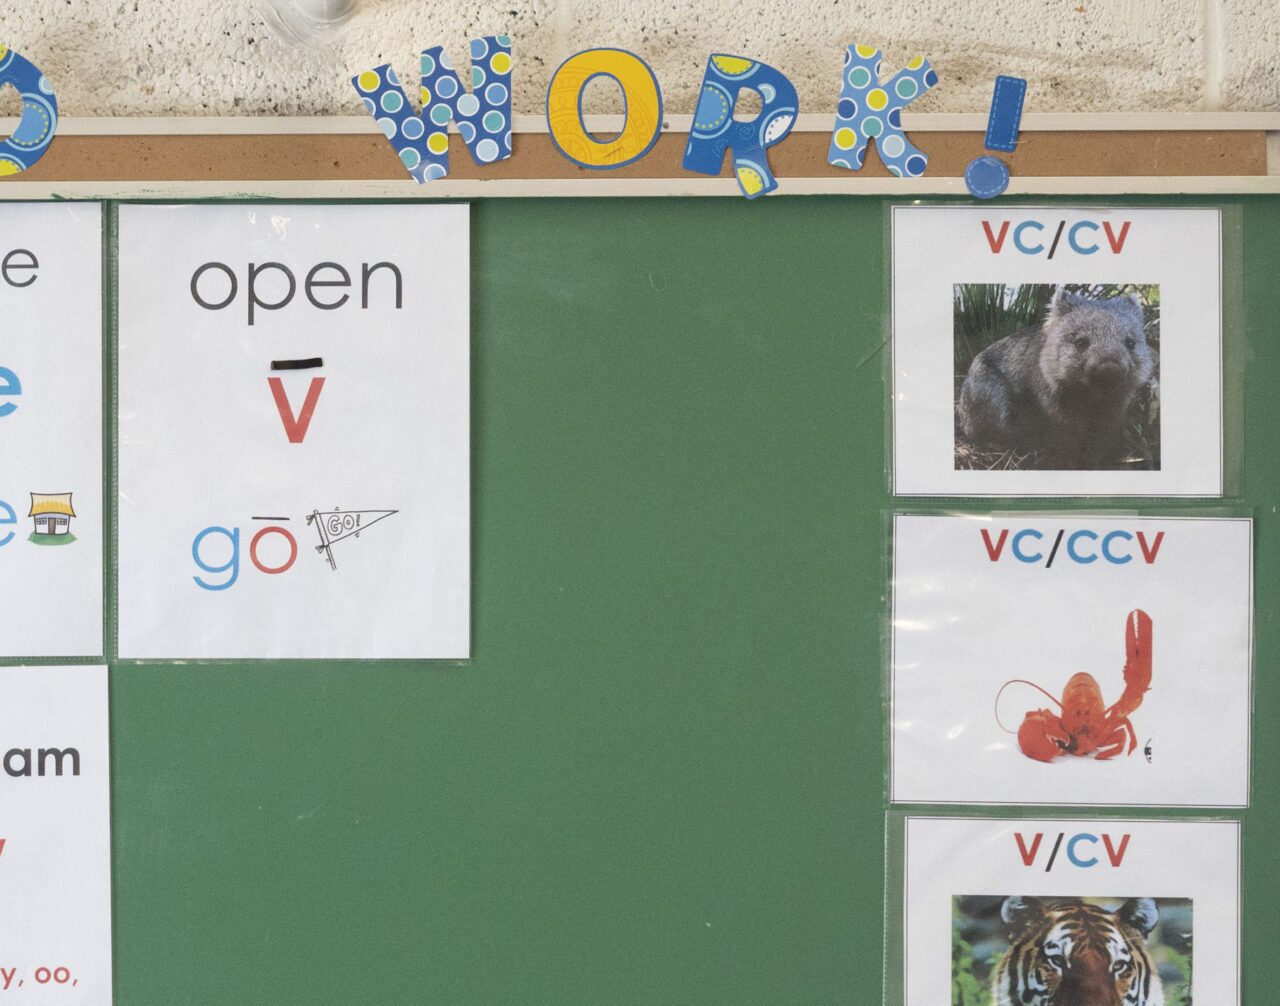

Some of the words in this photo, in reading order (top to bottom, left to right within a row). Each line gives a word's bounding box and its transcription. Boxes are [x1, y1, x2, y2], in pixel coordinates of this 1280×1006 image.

[351, 35, 1027, 199] WORK!
[981, 220, 1131, 260] VC/CV
[1, 249, 39, 287] e
[190, 262, 402, 325] open
[327, 514, 360, 536] GO!
[981, 529, 1164, 568] VC/CCV
[1014, 832, 1131, 872] V/CV
[35, 966, 78, 986] oo,
